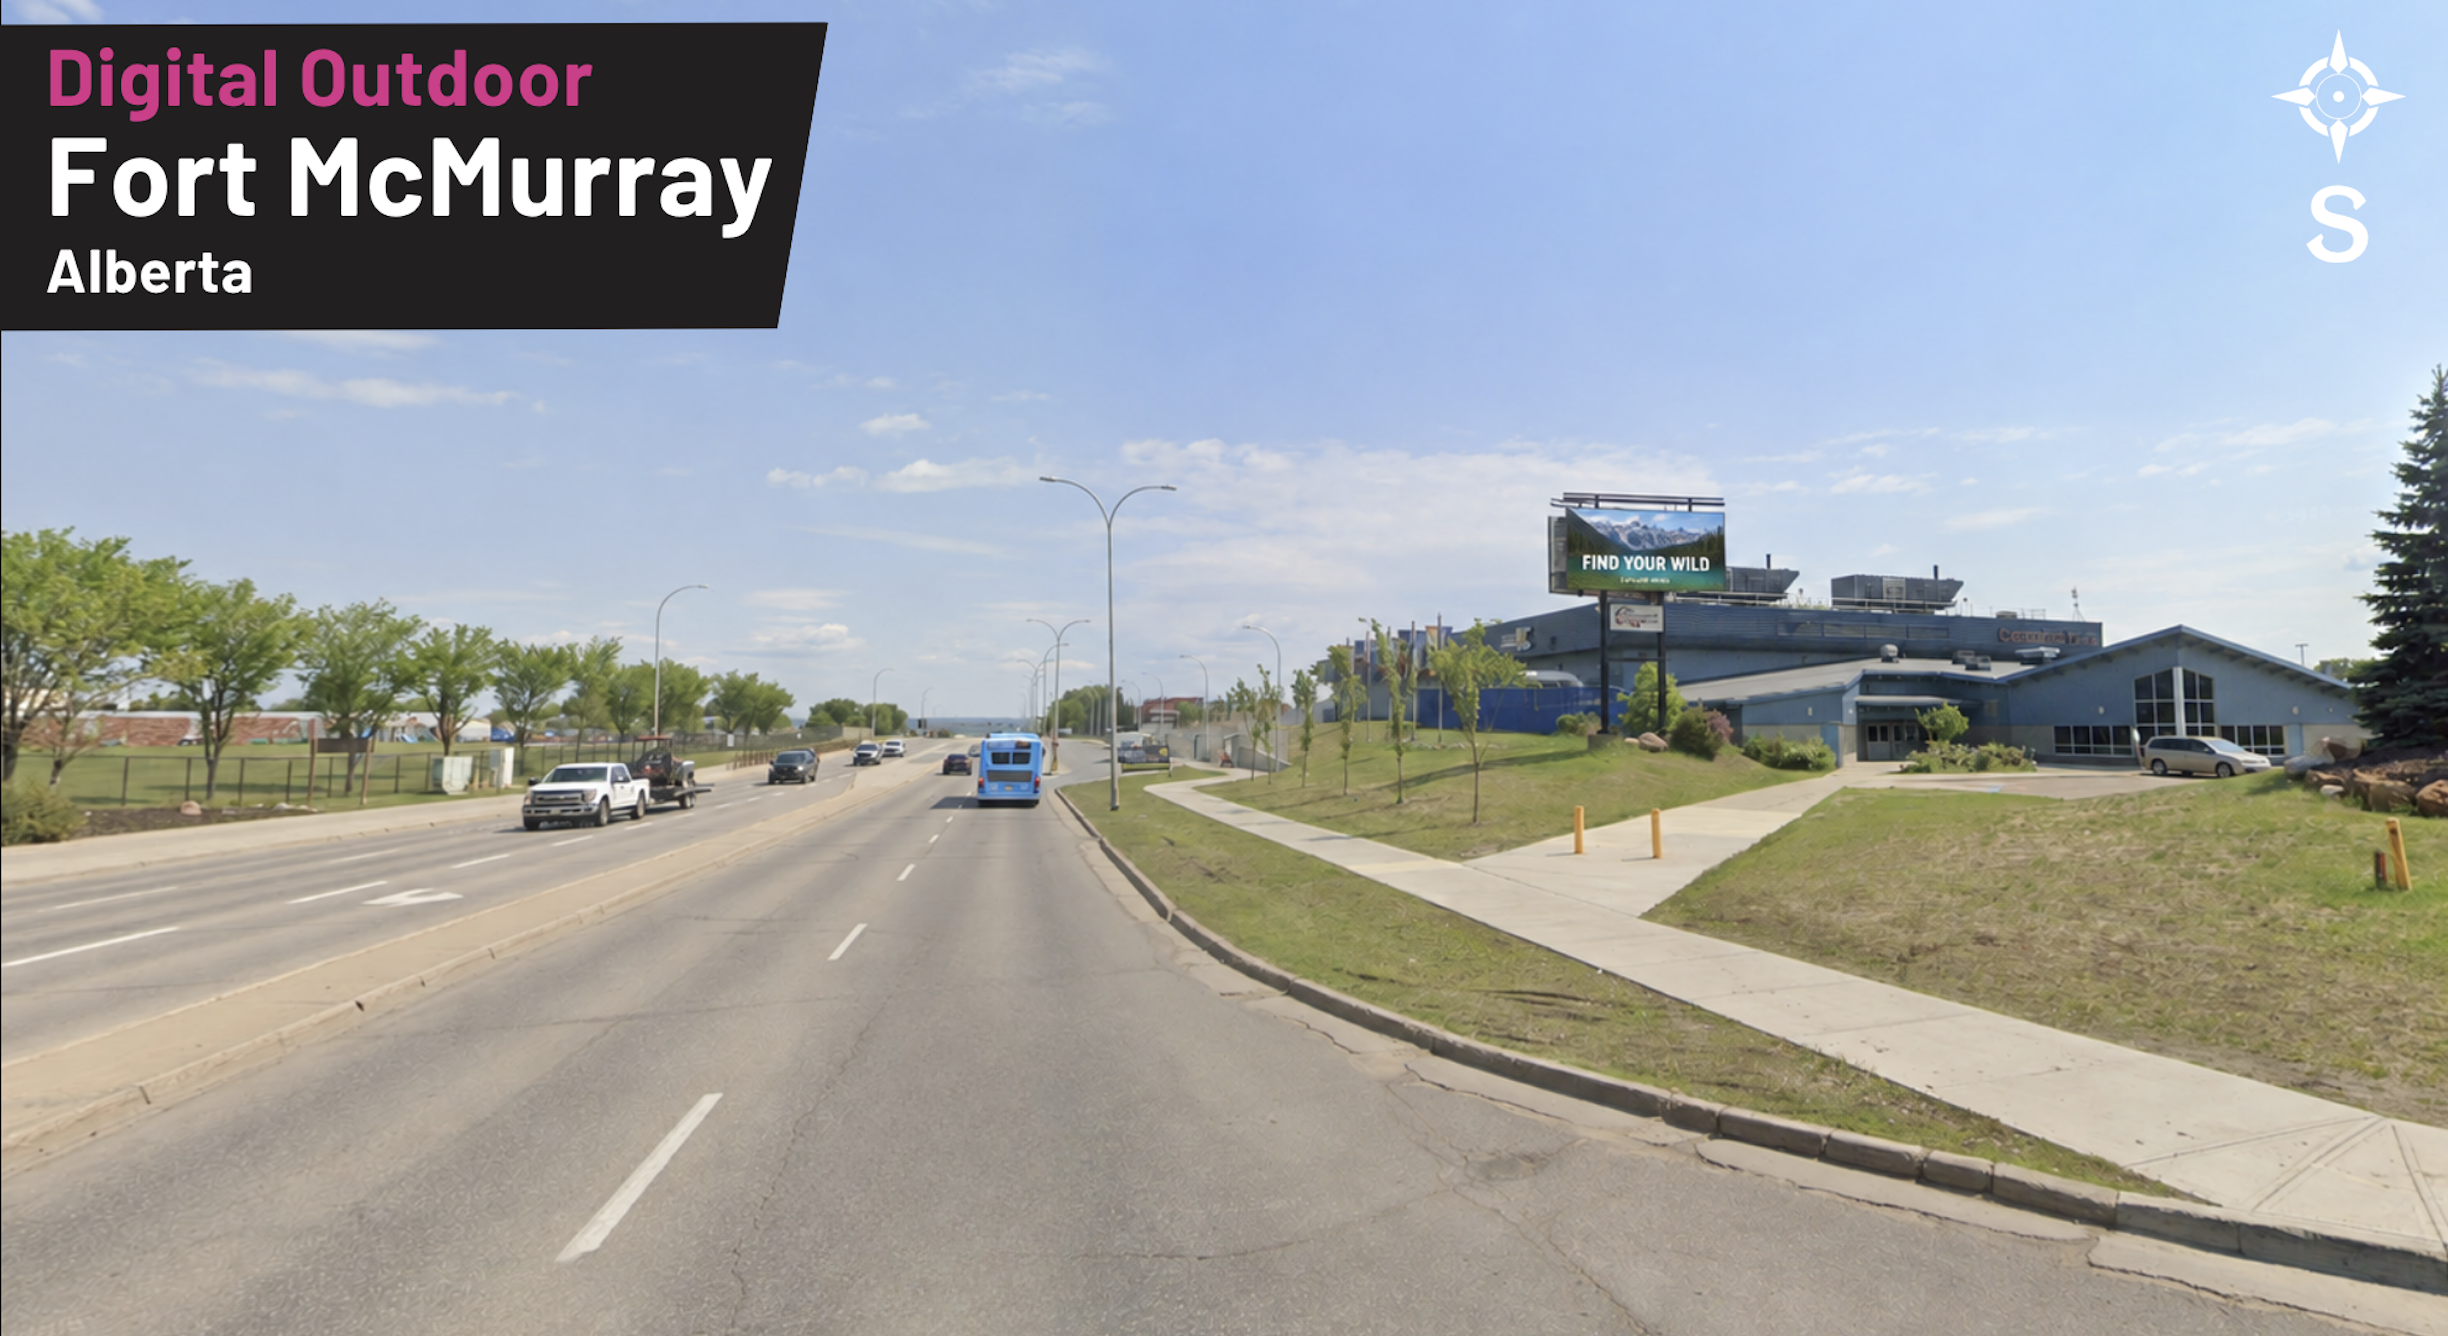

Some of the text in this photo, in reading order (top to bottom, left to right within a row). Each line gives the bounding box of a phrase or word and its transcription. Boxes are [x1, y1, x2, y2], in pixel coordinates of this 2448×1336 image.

[1582, 554, 1710, 572] FIND YOUR WILD
